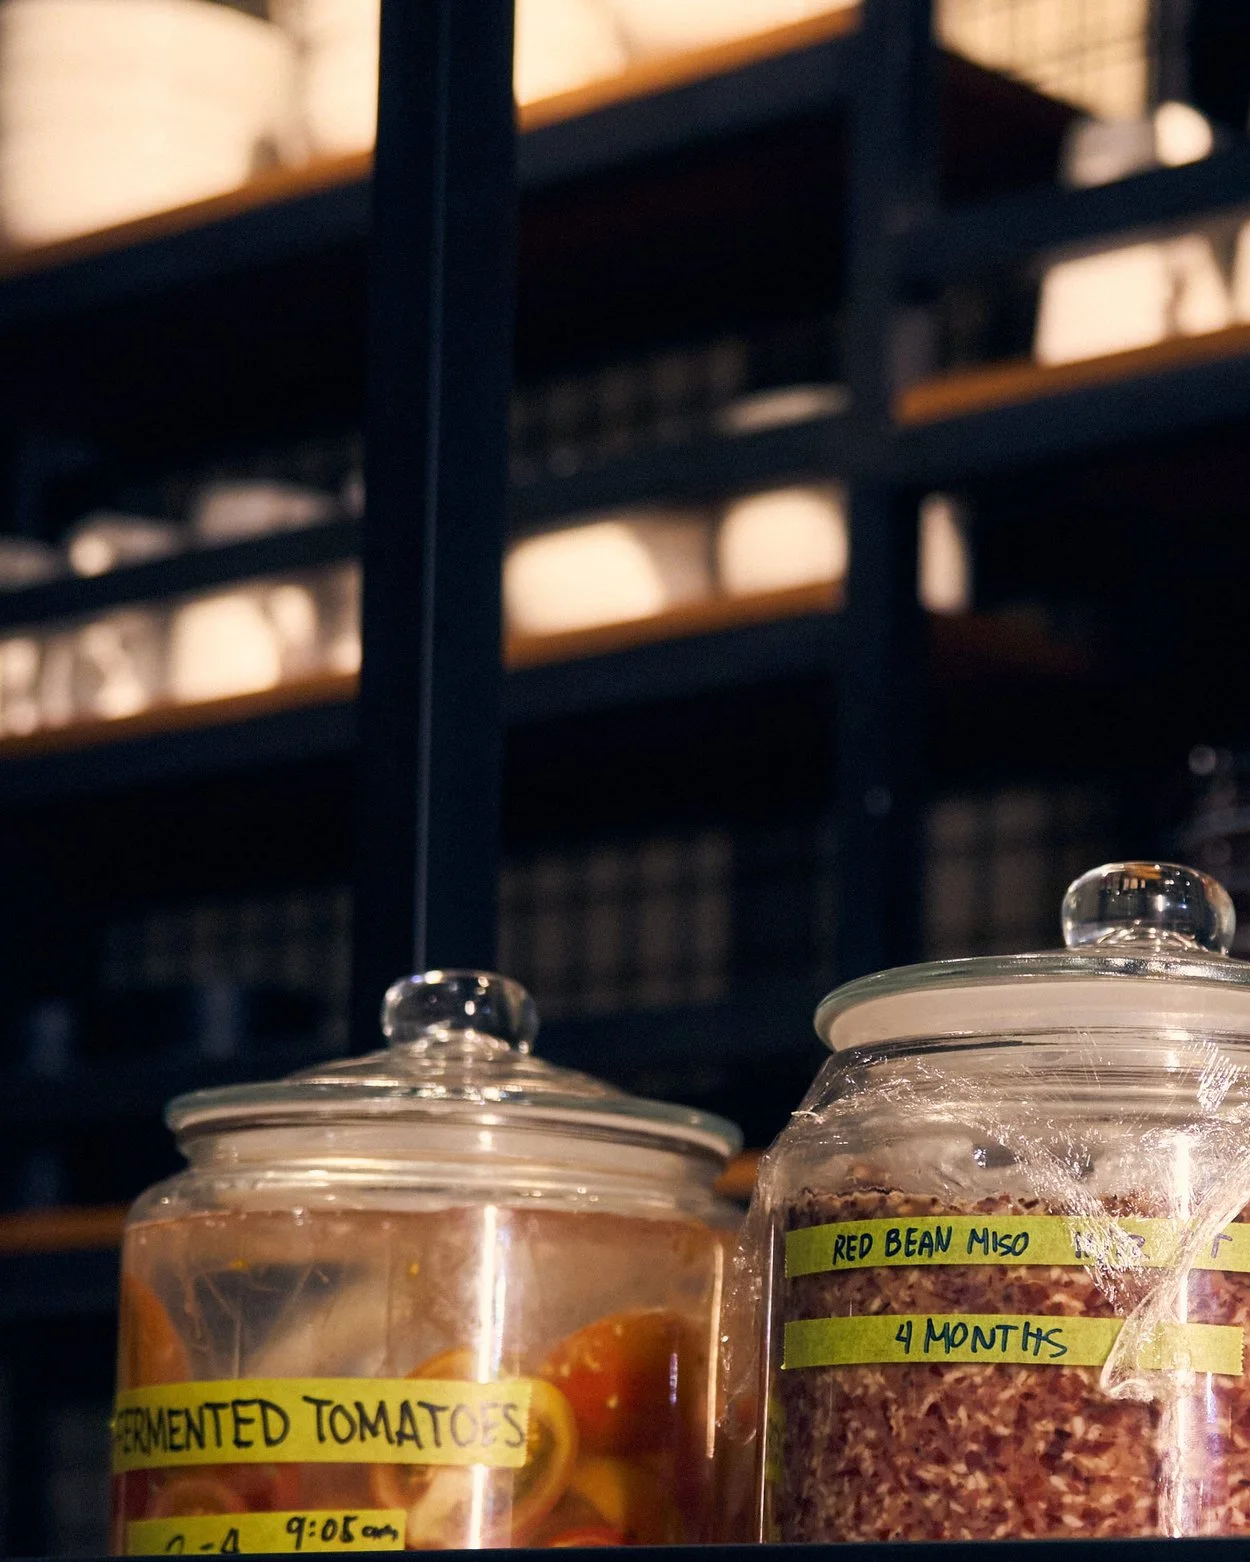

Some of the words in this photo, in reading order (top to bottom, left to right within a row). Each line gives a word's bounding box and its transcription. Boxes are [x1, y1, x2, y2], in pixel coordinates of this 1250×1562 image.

[832, 1232, 873, 1265] RED
[885, 1225, 952, 1258] BEAN
[967, 1227, 1029, 1256] MISO
[895, 1320, 913, 1354] 4
[923, 1317, 1068, 1358] MONTHS
[303, 1395, 525, 1449] TOMATOES
